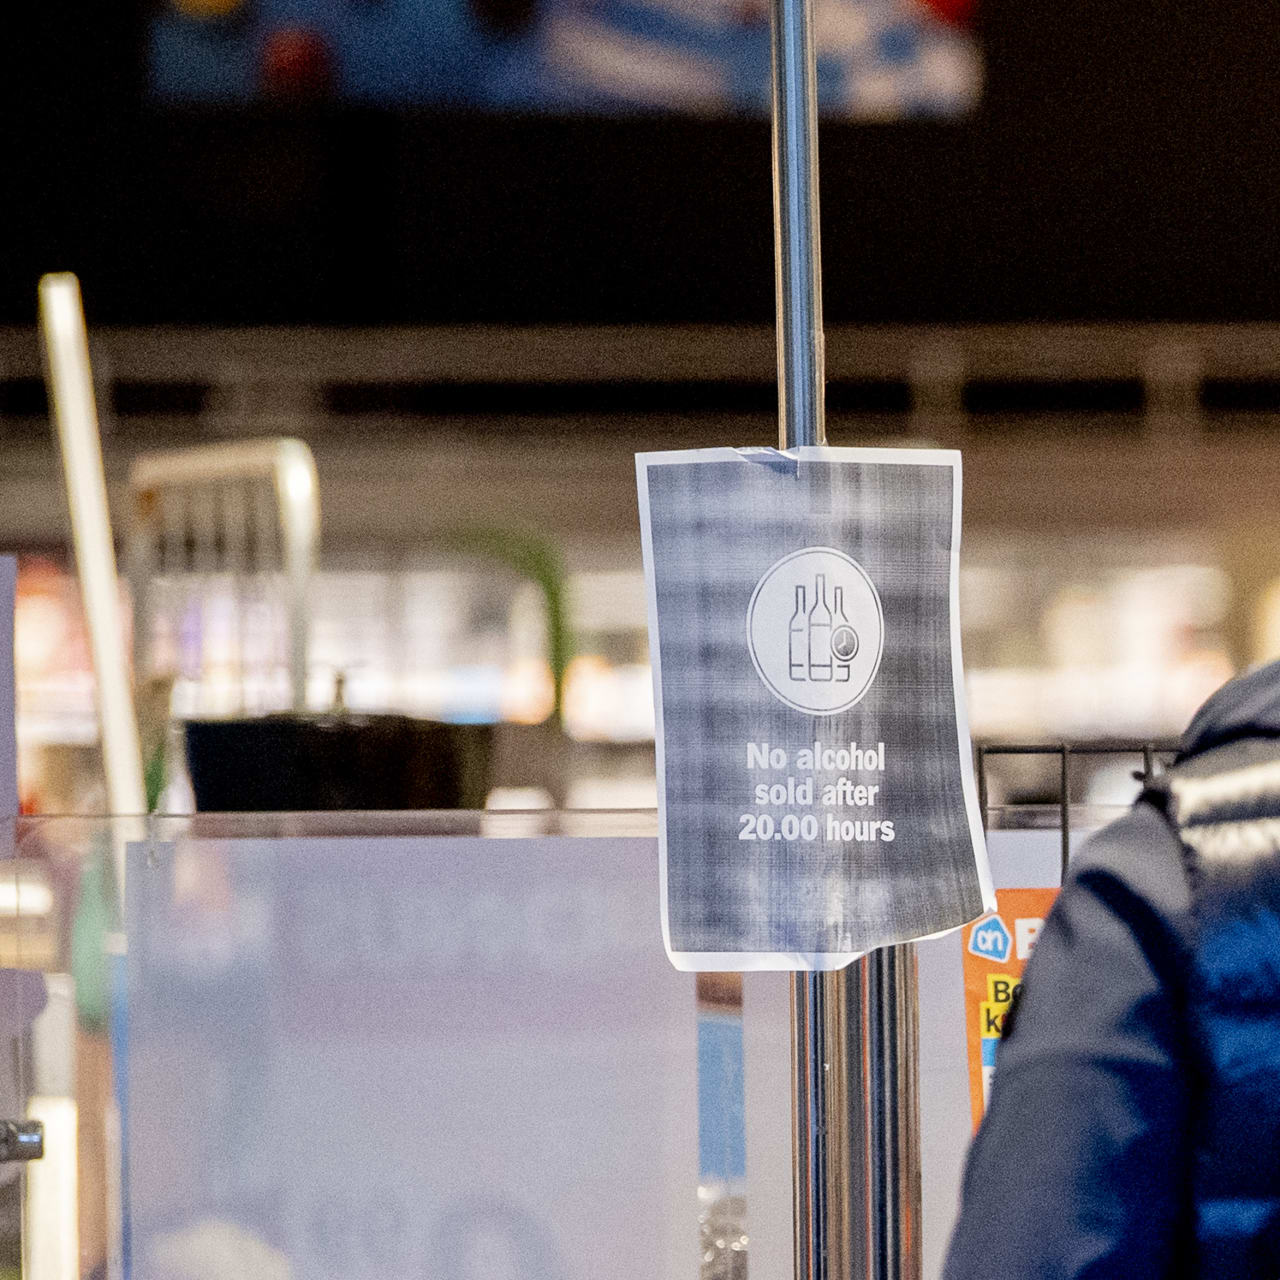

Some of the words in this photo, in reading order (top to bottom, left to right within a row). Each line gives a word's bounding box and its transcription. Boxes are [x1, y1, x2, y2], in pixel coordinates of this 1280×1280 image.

[746, 742, 787, 770] No
[797, 741, 885, 771] alcohol
[755, 777, 813, 806] sold
[822, 777, 879, 806] after
[738, 814, 819, 841] 20.00
[827, 813, 896, 842] hours
